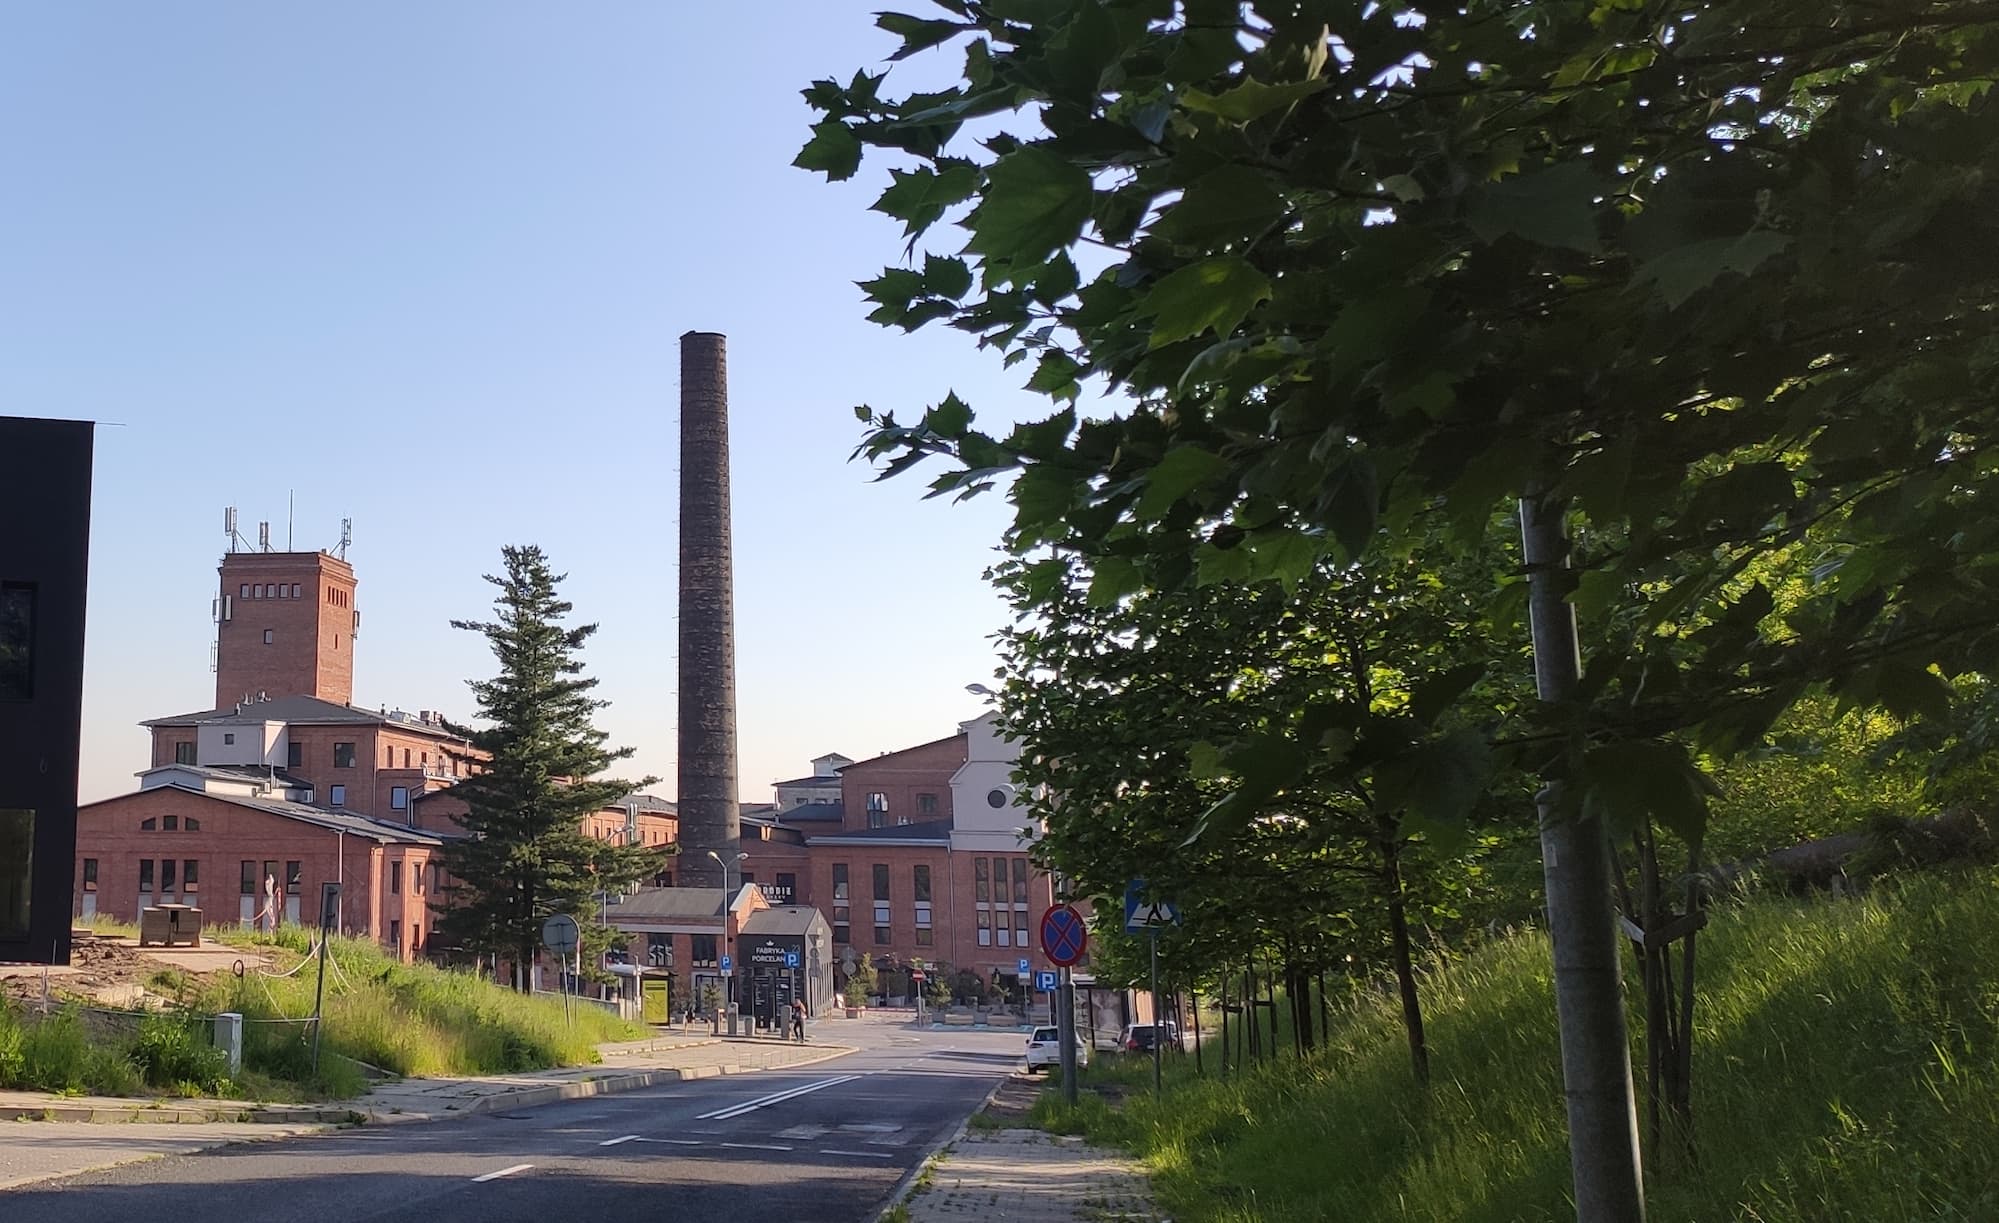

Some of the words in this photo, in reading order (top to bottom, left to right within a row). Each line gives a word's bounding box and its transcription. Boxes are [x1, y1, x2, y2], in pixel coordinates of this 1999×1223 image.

[752, 955, 786, 963] PORCELAN
[788, 954, 796, 966] P
[1042, 974, 1053, 988] P
